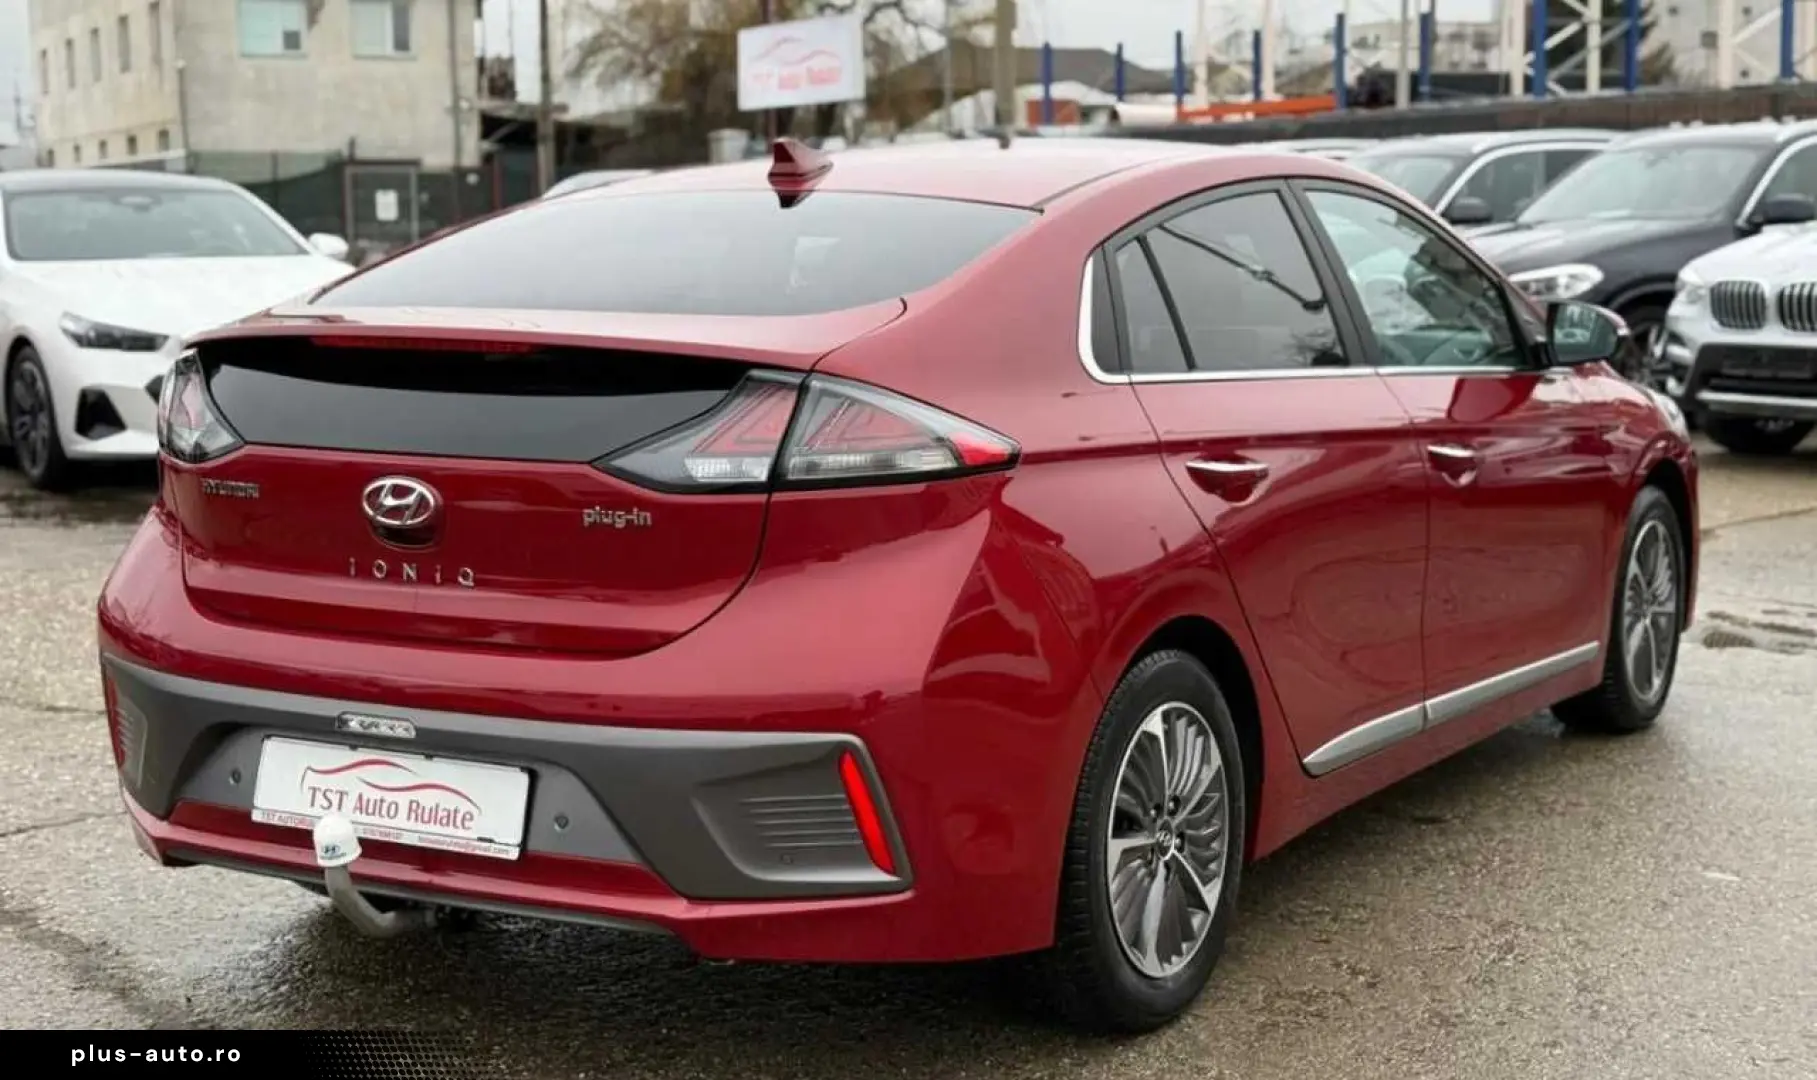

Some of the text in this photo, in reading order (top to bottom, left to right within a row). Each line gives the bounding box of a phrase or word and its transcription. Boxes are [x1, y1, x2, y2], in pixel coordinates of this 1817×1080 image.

[583, 505, 652, 528] plug-in
[308, 785, 474, 831] TST Auto Rulate
